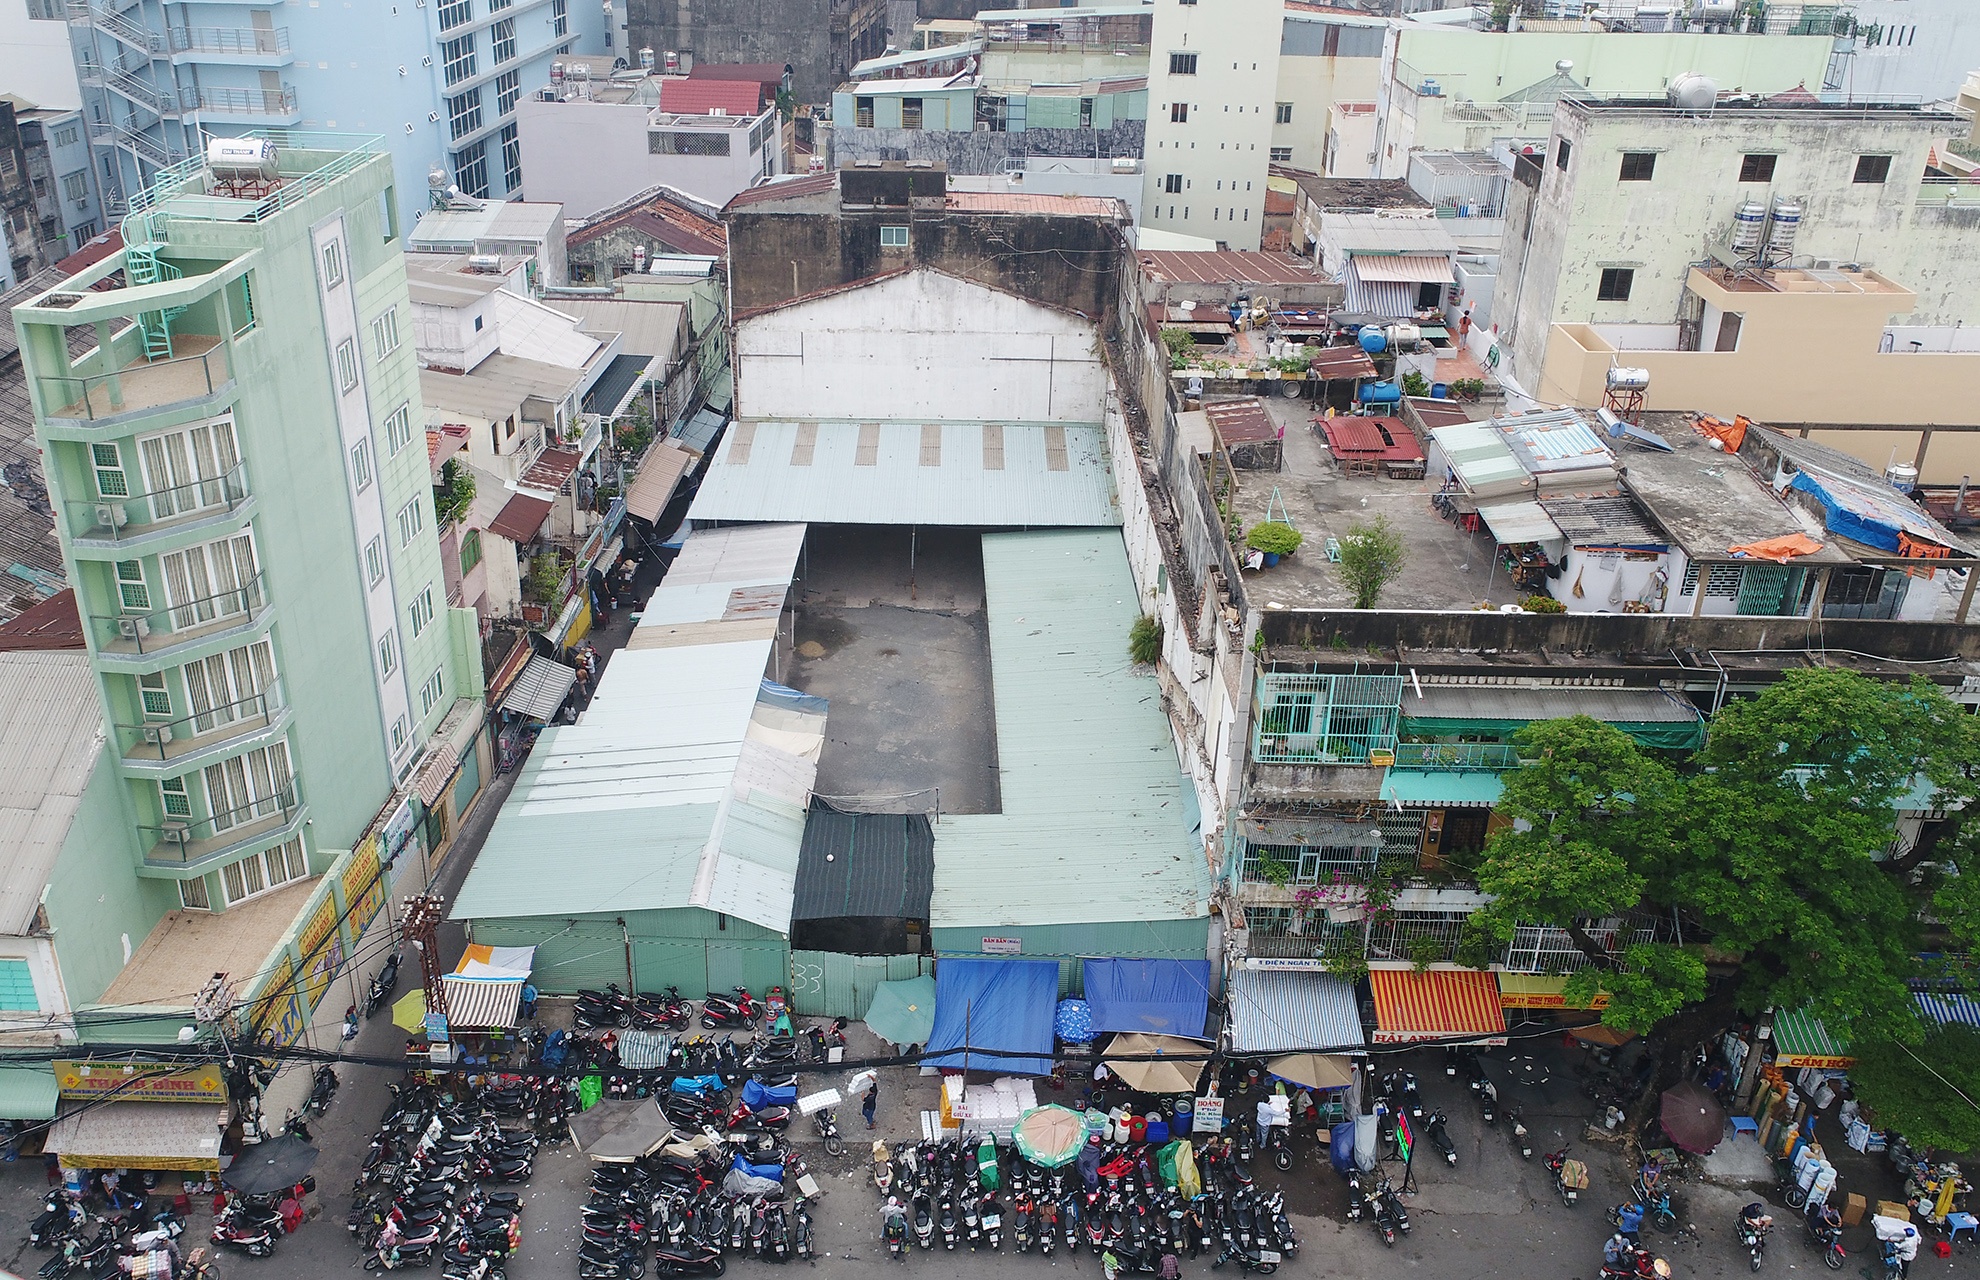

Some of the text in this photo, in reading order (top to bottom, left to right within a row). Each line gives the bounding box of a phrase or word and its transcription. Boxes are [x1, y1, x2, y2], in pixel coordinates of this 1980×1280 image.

[795, 963, 823, 994] 33
[1502, 996, 1516, 1004] CÔNG
[1544, 996, 1565, 1005] TRƯỜN
[1375, 1032, 1403, 1043] HẢI
[1791, 1055, 1824, 1067] CẨM
[152, 1077, 196, 1090] BÌNH
